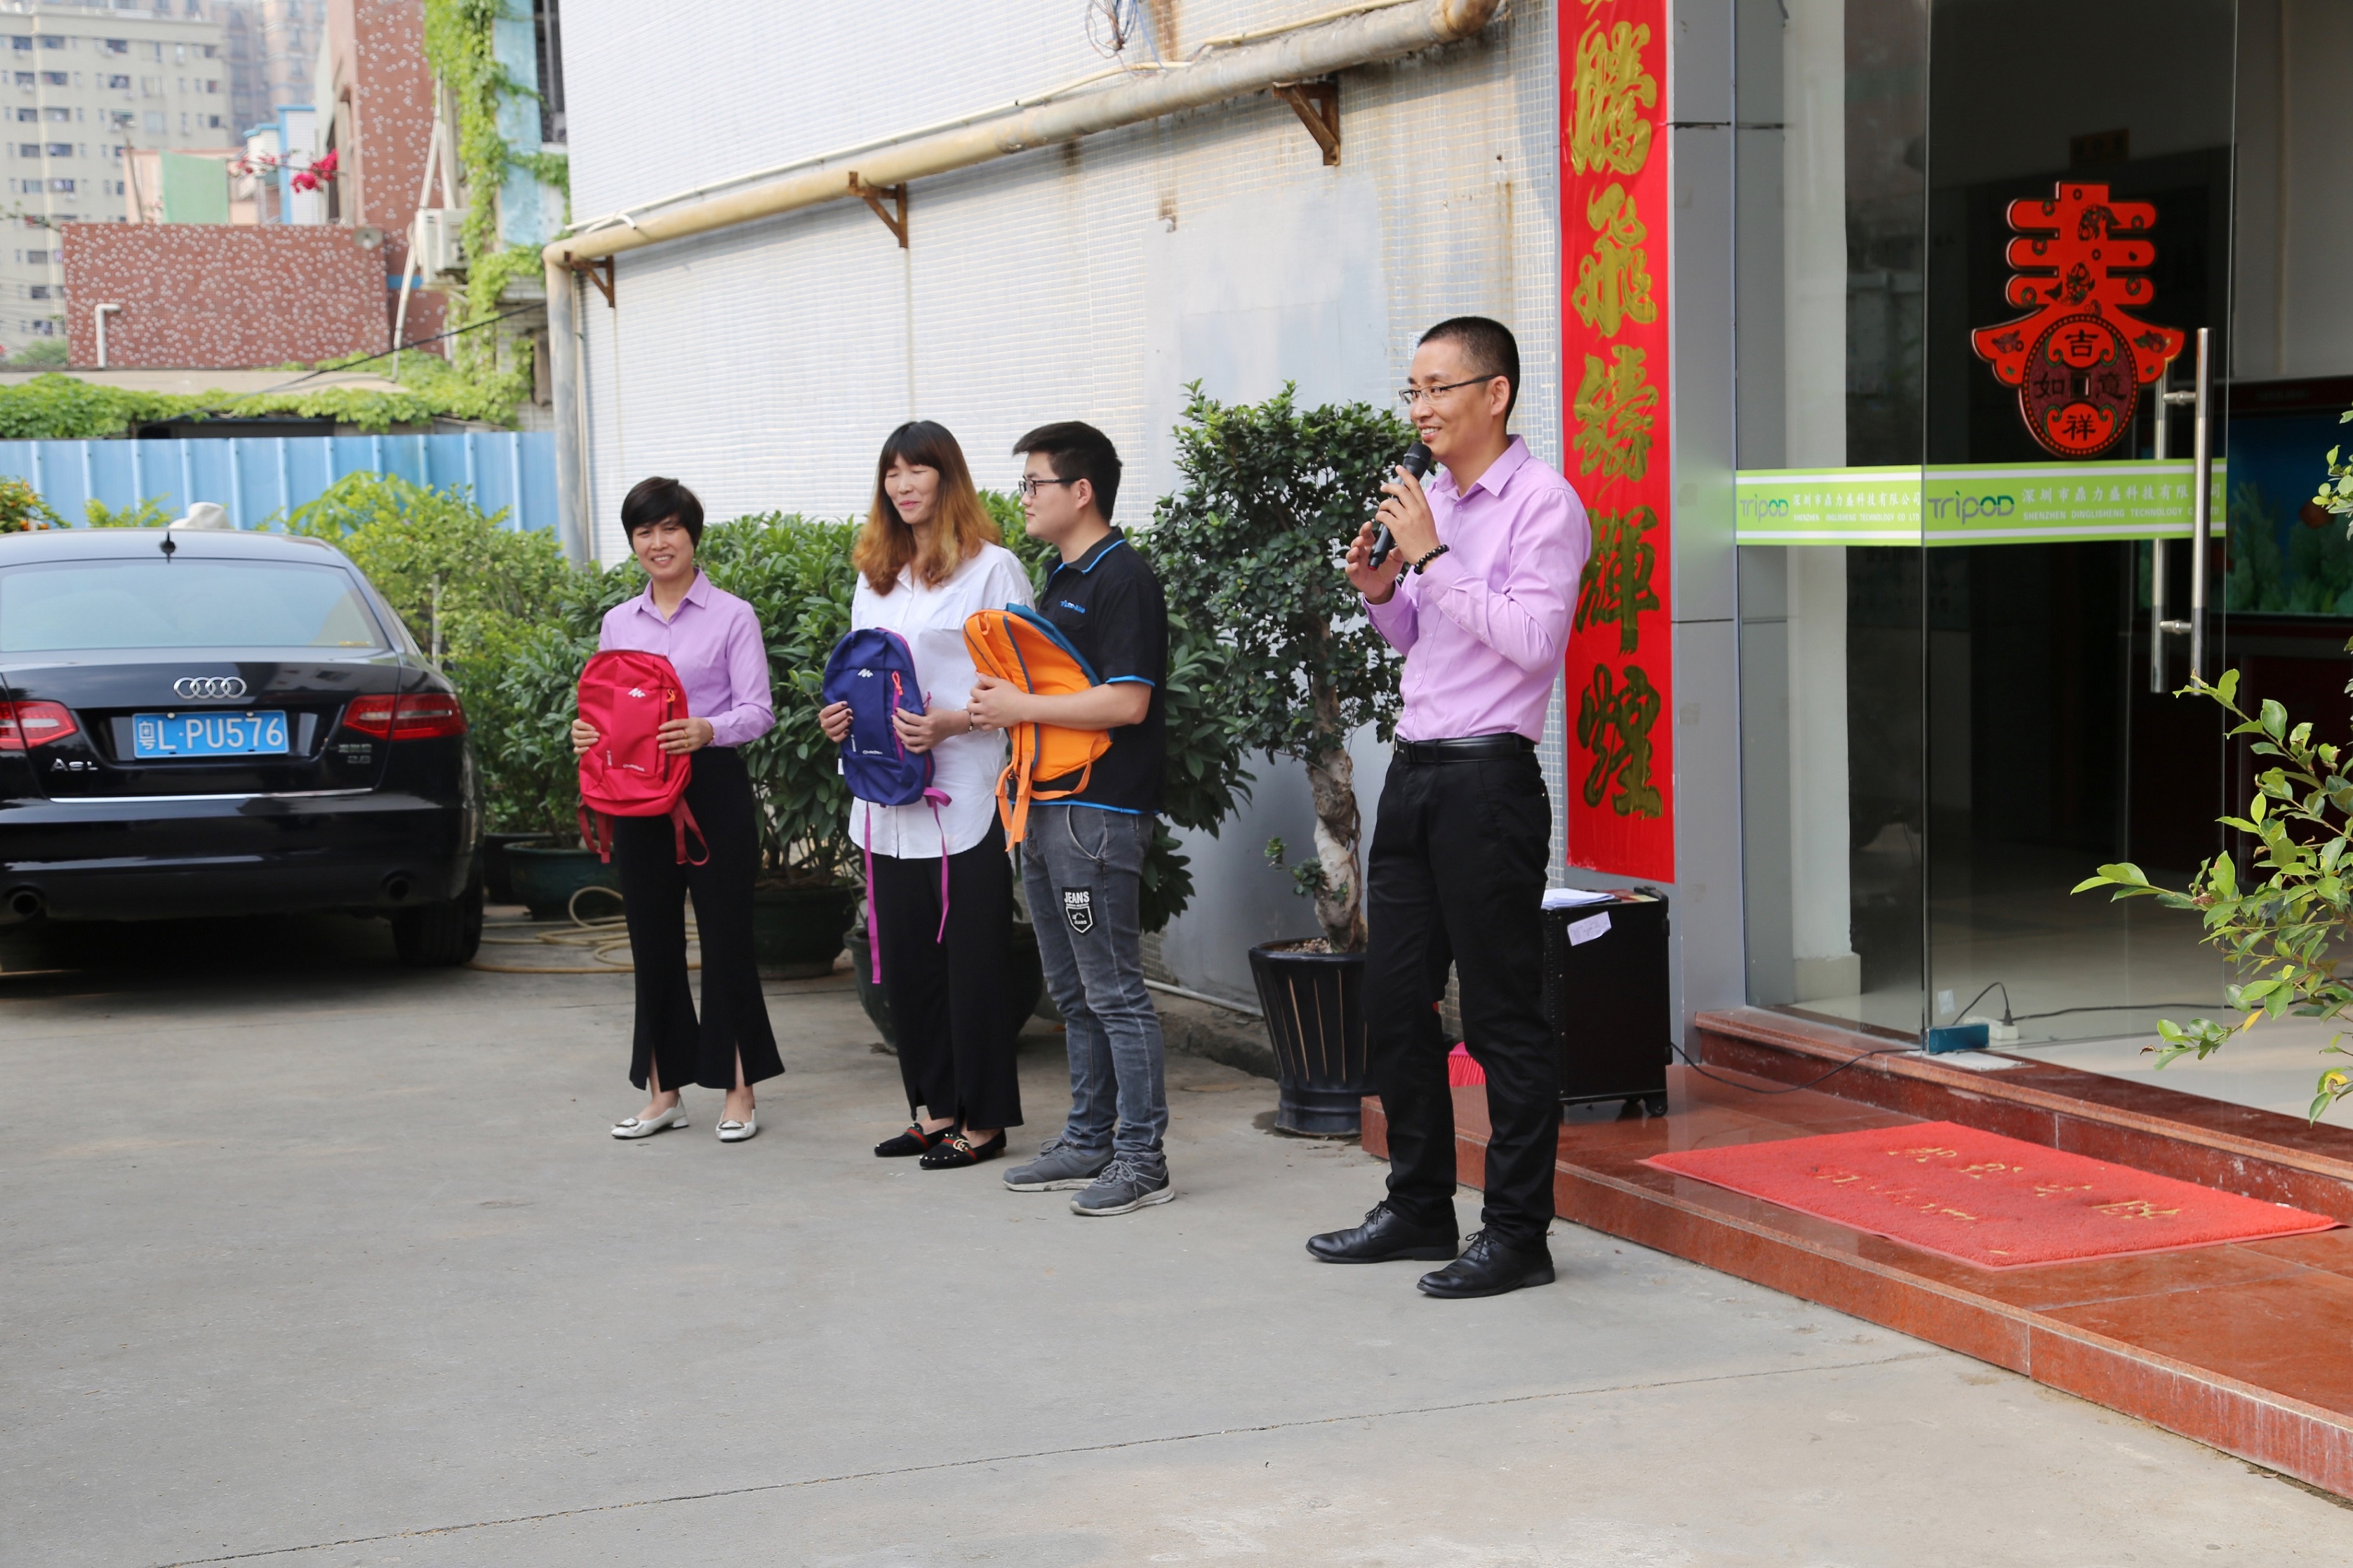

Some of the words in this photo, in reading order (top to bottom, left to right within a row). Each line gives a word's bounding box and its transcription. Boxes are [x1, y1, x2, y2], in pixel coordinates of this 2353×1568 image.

[2065, 329, 2099, 358] 吉
[2062, 414, 2096, 441] 祥
[2022, 483, 2220, 503] 深圳市鼎力盛科技有限司
[1859, 513, 1894, 521] TECHNOLOGY
[1910, 513, 1920, 521] LTD
[2024, 511, 2066, 521] SHENZHEN
[2072, 508, 2125, 519] DINGLISHENG
[2131, 507, 2183, 517] TECHNOLOGY
[1064, 891, 1090, 904] JEANS
